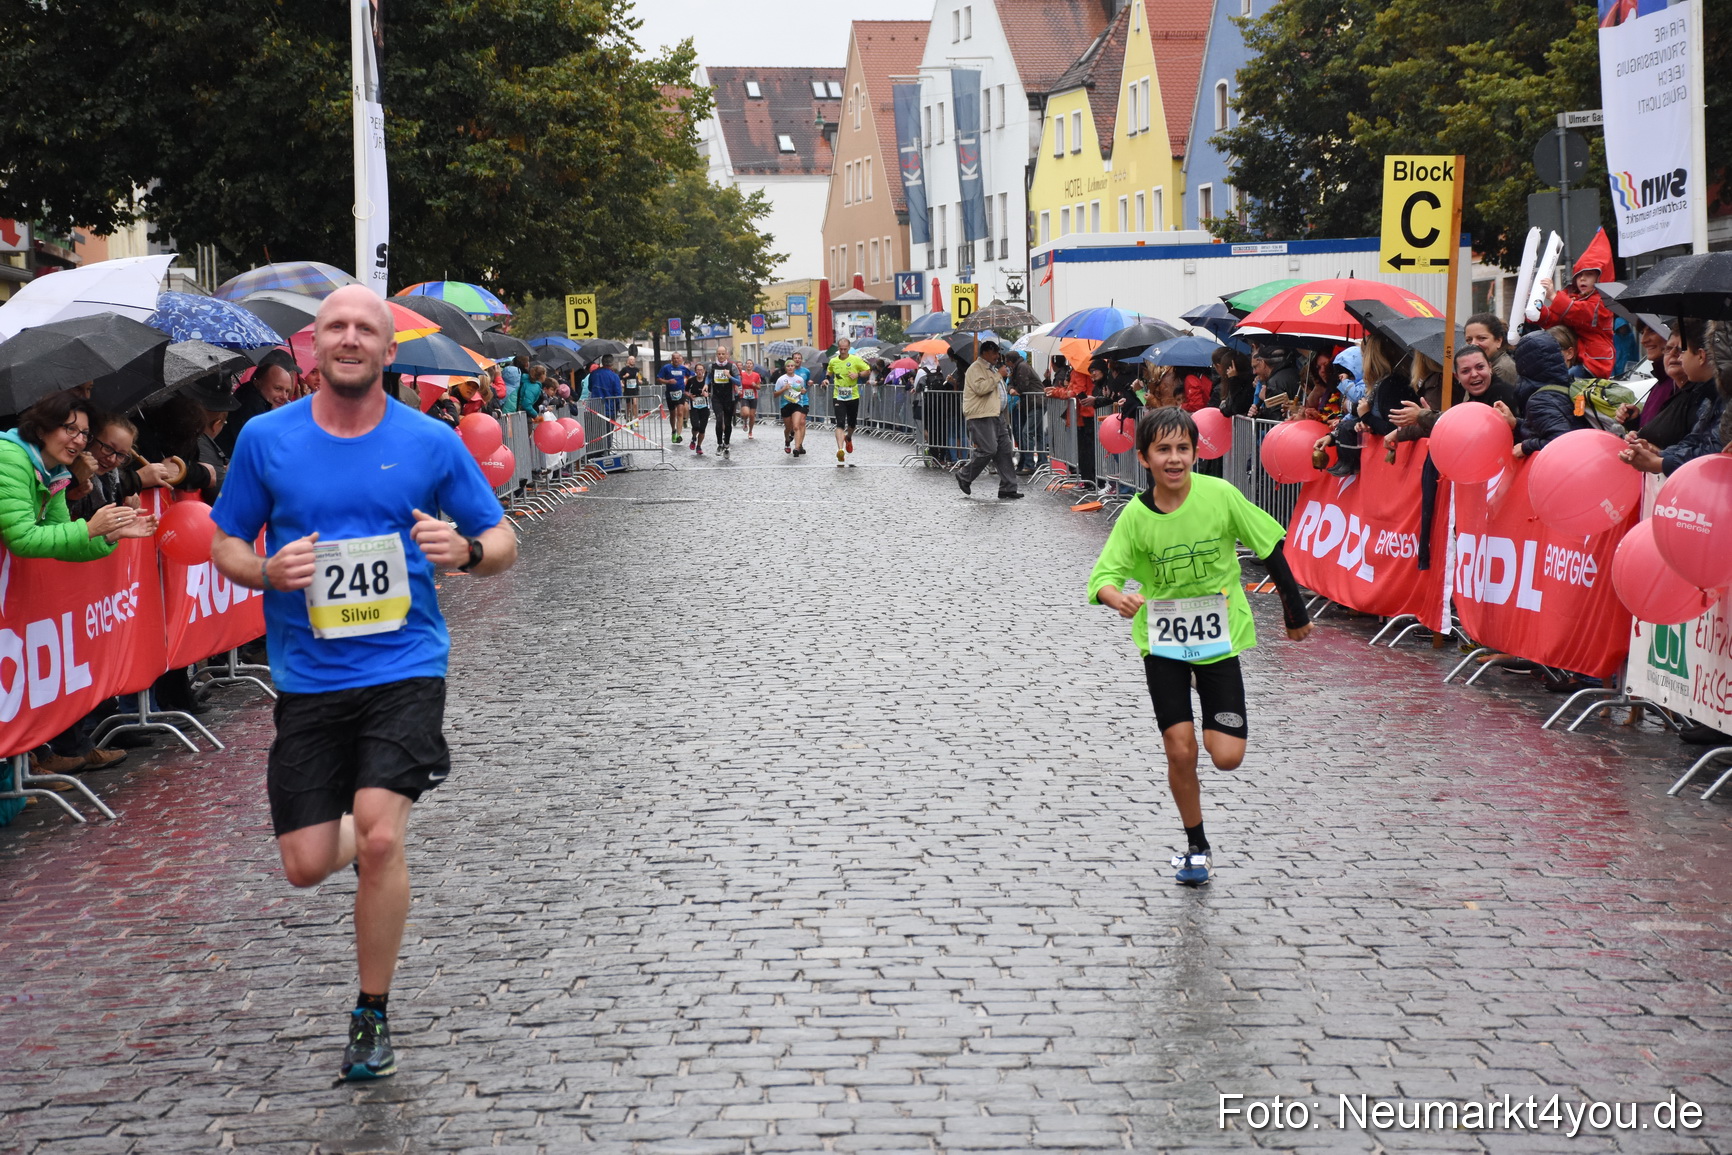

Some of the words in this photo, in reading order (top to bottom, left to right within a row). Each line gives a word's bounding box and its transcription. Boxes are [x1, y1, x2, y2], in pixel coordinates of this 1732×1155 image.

[1568, 114, 1590, 124] Ulmer
[1393, 161, 1454, 181] Block
[1065, 178, 1083, 199] HOTEL
[1400, 190, 1441, 248] C
[954, 285, 976, 294] Block
[570, 296, 592, 305] Block
[958, 297, 971, 318] D
[574, 308, 590, 330] D
[325, 560, 390, 600] 248
[341, 606, 380, 623] Silvio
[1181, 598, 1219, 611] BOCK
[1156, 612, 1222, 643] 2643
[1182, 649, 1200, 659] Jan
